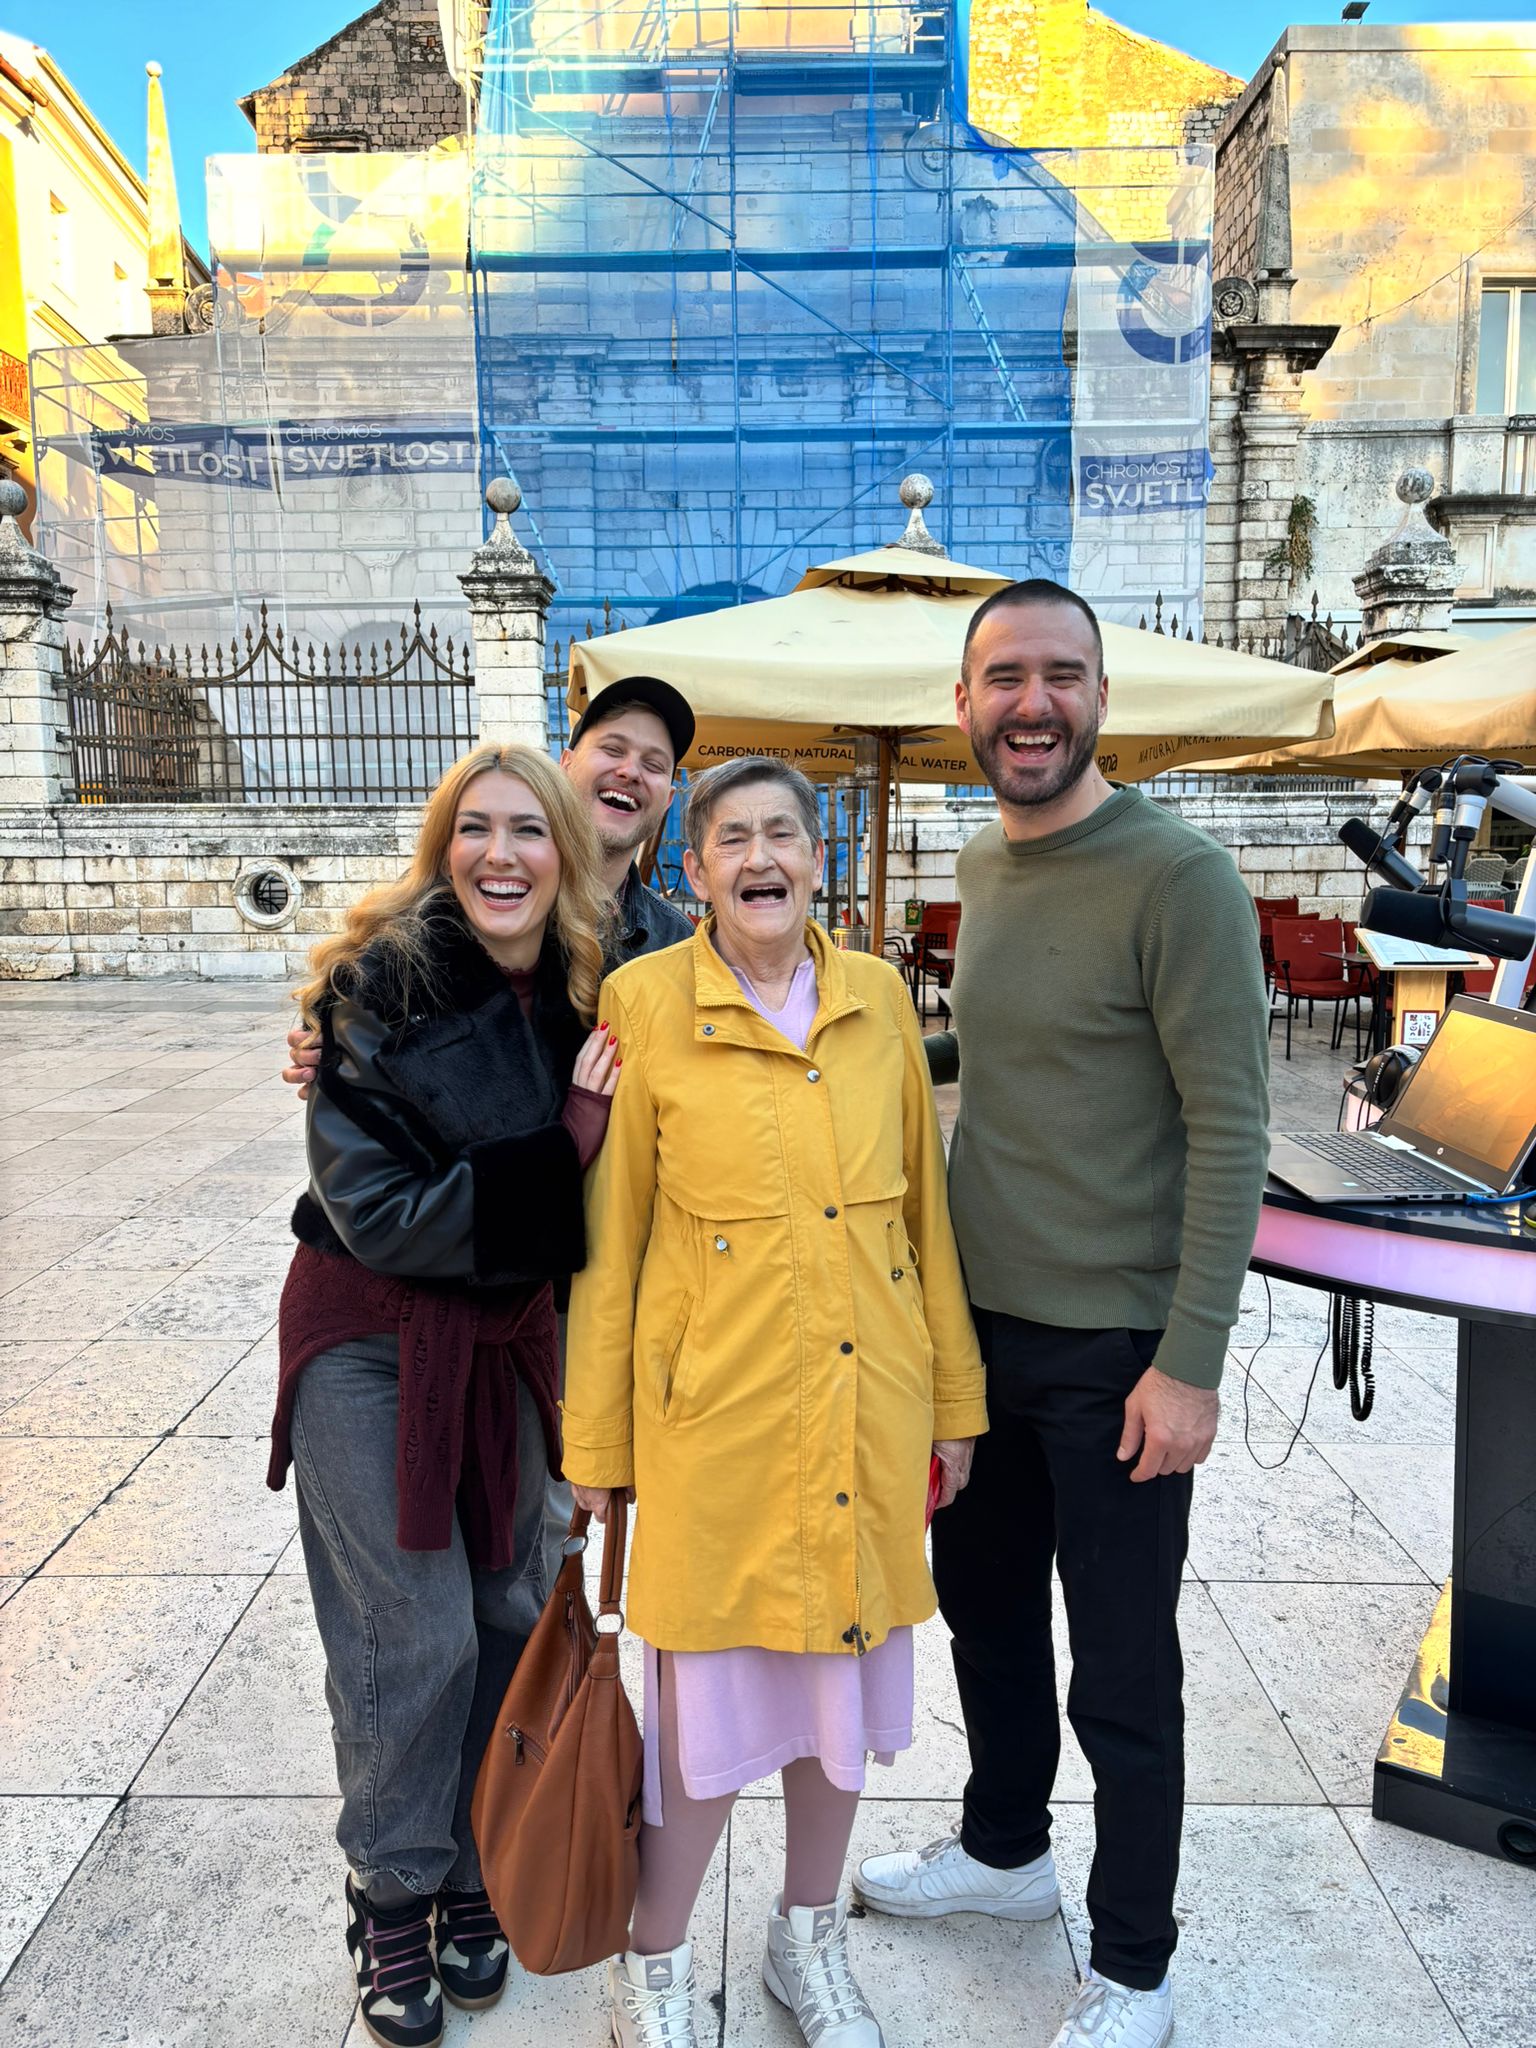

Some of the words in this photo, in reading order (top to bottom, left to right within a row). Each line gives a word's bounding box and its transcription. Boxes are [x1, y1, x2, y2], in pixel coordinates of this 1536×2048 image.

[286, 423, 382, 444] CHROMOS
[287, 440, 471, 473] SVJETLOST
[1085, 459, 1181, 480] CHROMOS
[697, 744, 791, 759] CARBONATED
[793, 747, 856, 760] NATURAL
[1137, 739, 1176, 765] NATURAL
[920, 757, 968, 771] WATER
